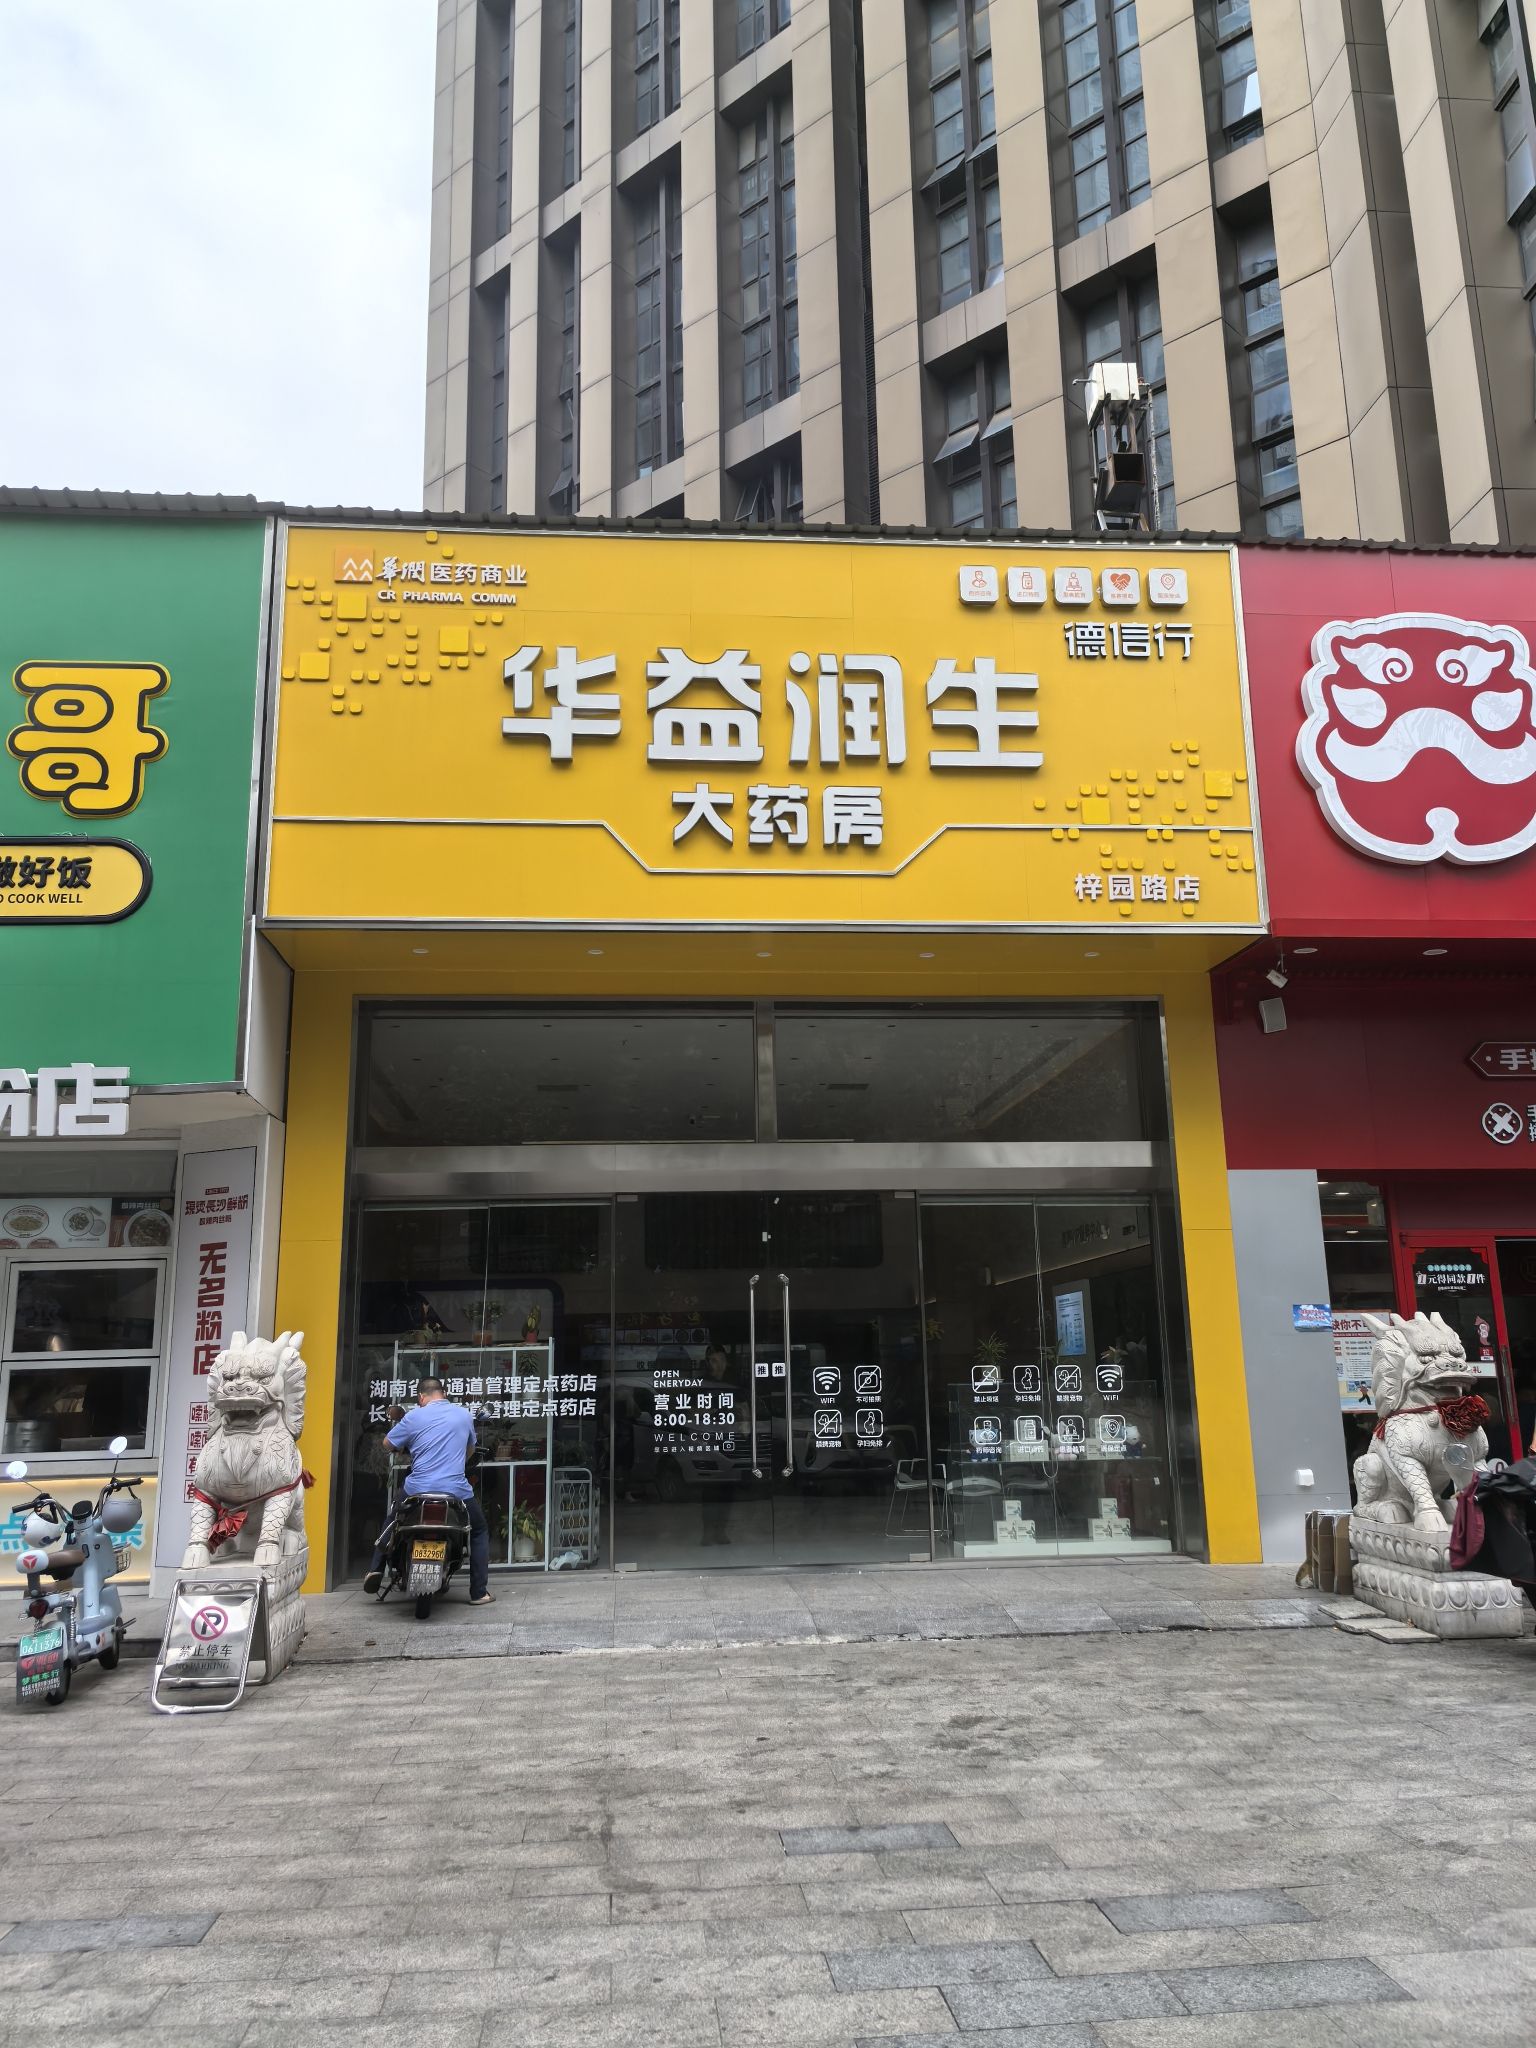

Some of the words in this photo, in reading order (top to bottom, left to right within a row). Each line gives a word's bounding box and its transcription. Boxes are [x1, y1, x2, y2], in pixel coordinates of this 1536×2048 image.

[378, 590, 396, 601] CR
[403, 591, 464, 604] PHARMA
[472, 592, 517, 604] COMM
[1064, 621, 1195, 660] 德信行
[502, 646, 1044, 769] 华益润生
[8, 661, 170, 818] 哥
[671, 782, 885, 848] 大药房
[1075, 873, 1200, 902] 梓园路店
[8, 893, 46, 904] COOK
[48, 893, 84, 904] WELL
[193, 1241, 228, 1376] 无名粉店
[653, 1370, 680, 1378] OPEN
[757, 1366, 767, 1376] 推
[774, 1365, 784, 1375] 推
[369, 1374, 598, 1399] 湖南省通道管理定点药店
[653, 1379, 703, 1388] ENERYDAY
[654, 1392, 734, 1411] 营业时间
[653, 1412, 735, 1427] 8:00-18:30
[654, 1431, 735, 1442] WELCOME
[179, 1643, 233, 1658] 禁止停车
